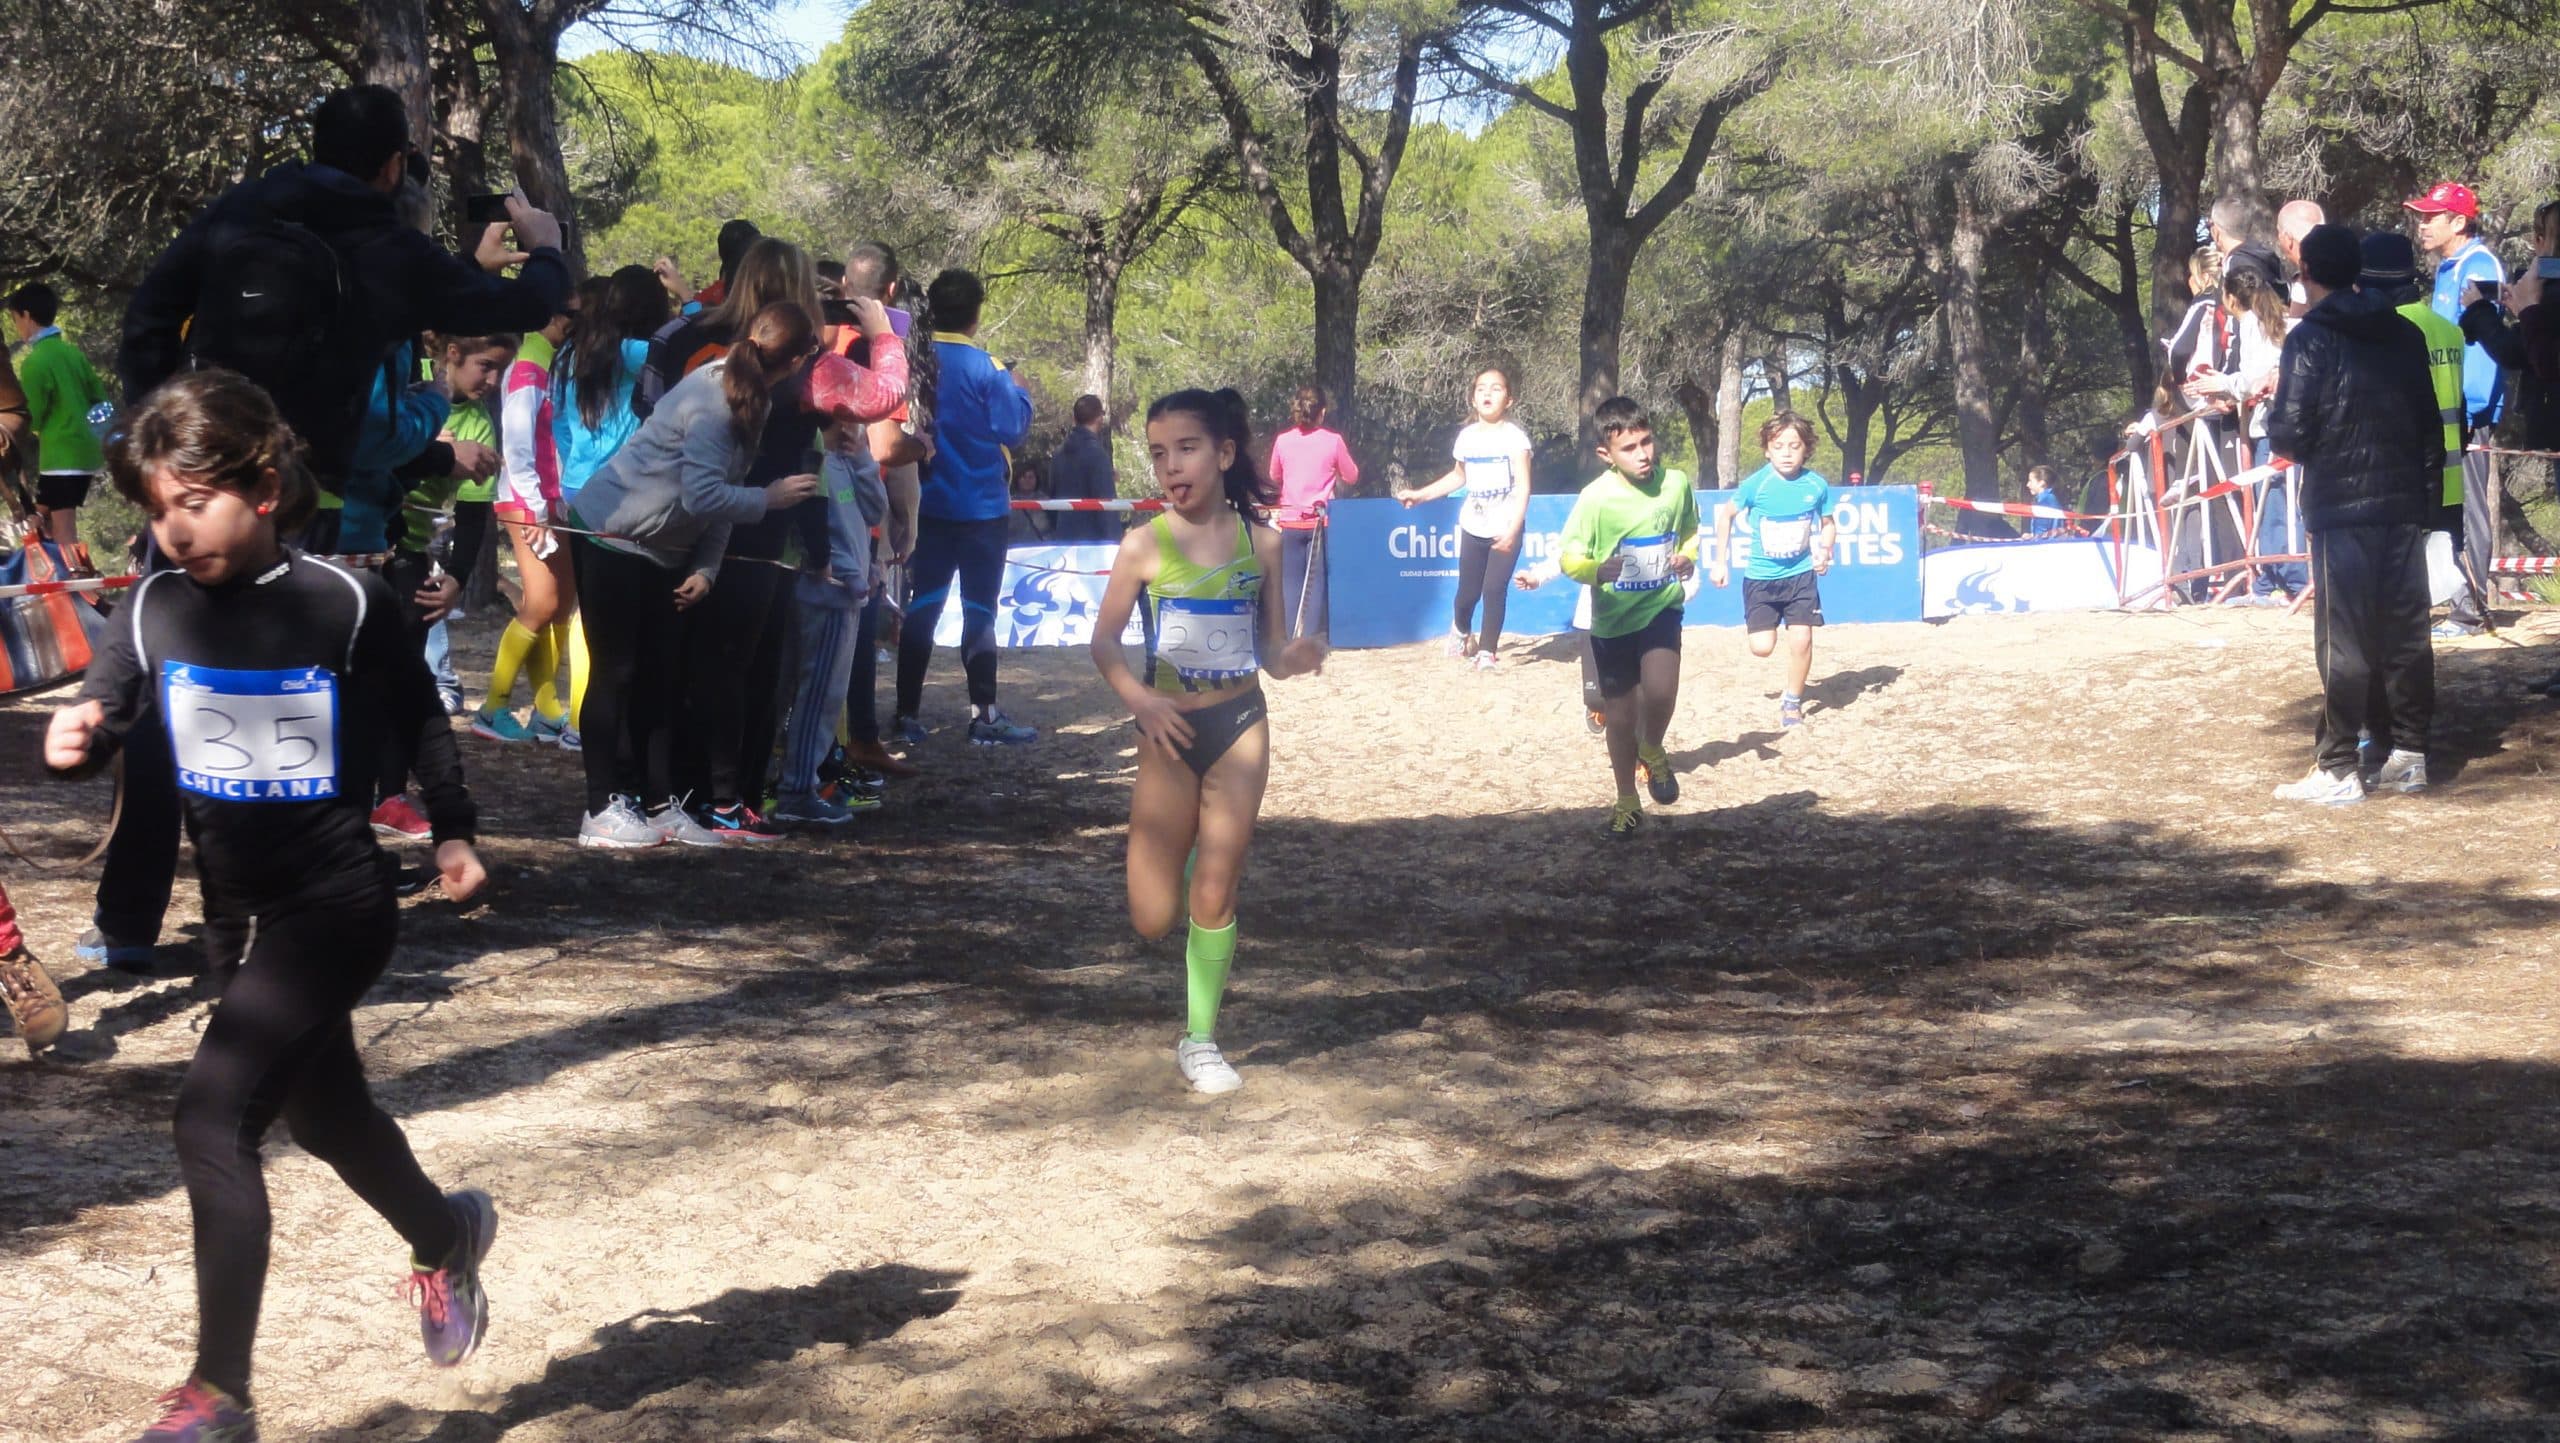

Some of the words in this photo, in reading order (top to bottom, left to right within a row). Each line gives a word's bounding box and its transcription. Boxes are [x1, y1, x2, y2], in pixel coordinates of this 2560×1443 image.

[1701, 533, 1904, 568] DETES
[196, 707, 319, 772] 35
[179, 770, 334, 798] CHICLANA
